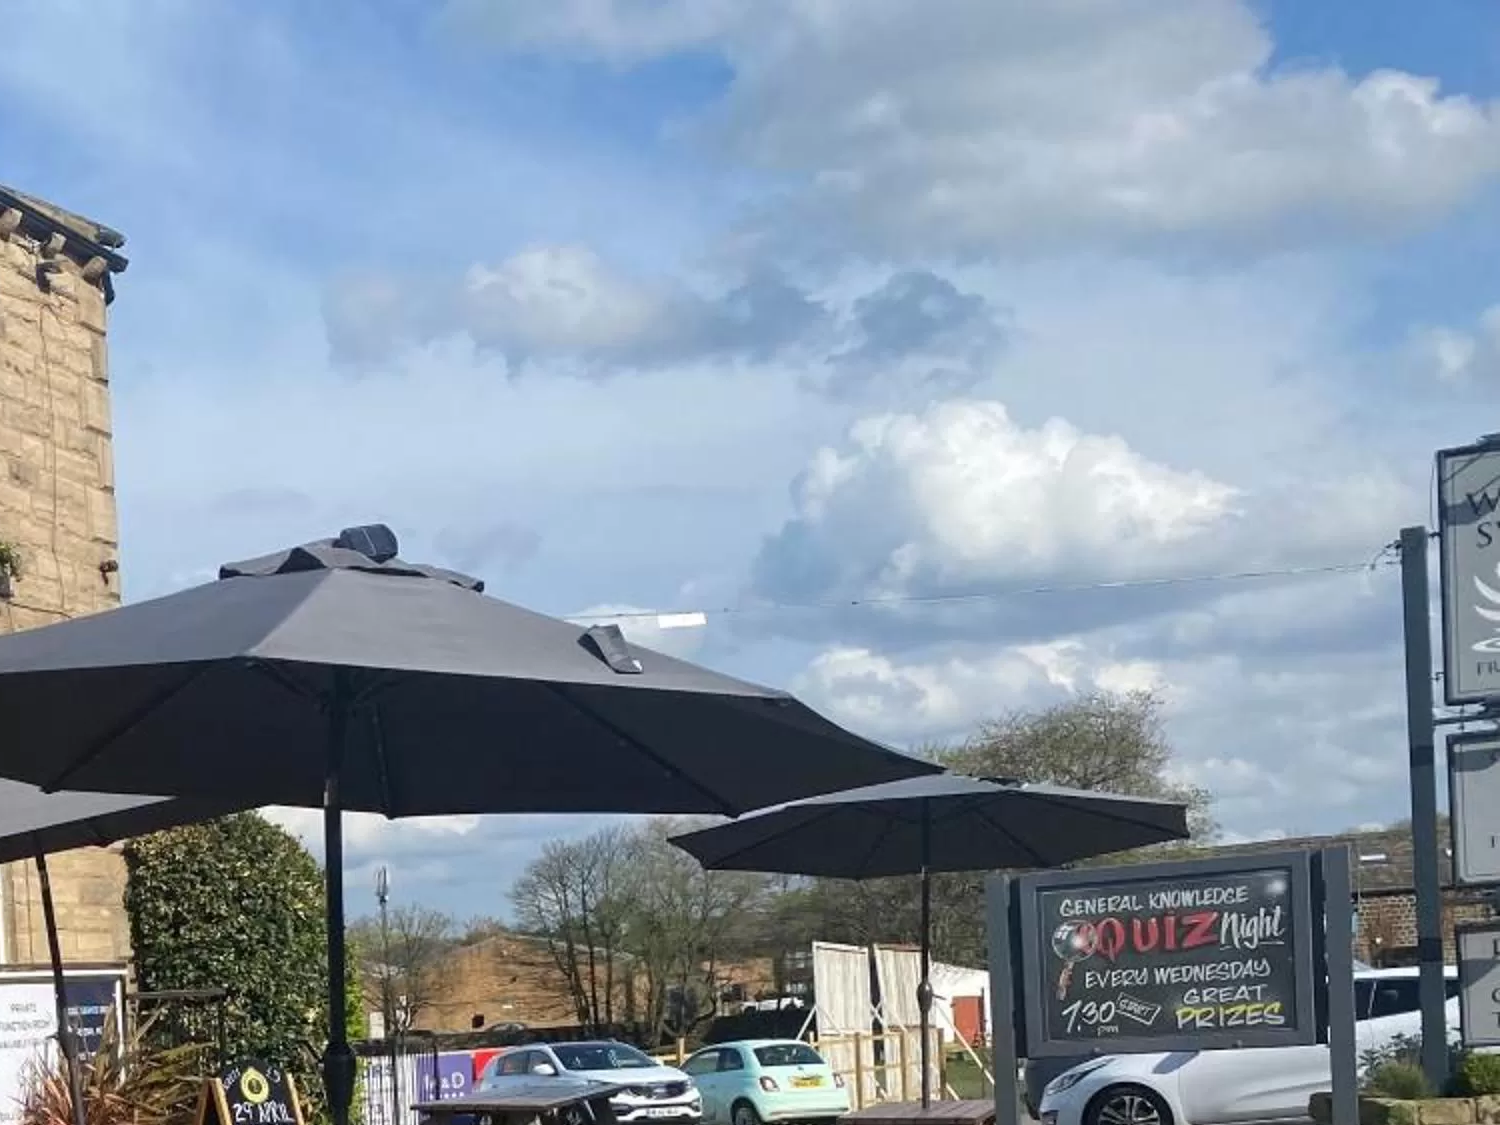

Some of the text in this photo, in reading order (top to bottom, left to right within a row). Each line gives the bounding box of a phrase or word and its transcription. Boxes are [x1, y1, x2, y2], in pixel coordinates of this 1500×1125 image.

[1059, 885, 1250, 917] GENERAL KNOWLEDGE
[1097, 905, 1285, 962] QUIZ Night
[1085, 957, 1271, 989] EVERY WEDNESDAY
[1184, 983, 1269, 1006] GREAT
[1175, 1001, 1286, 1030] PRIZES
